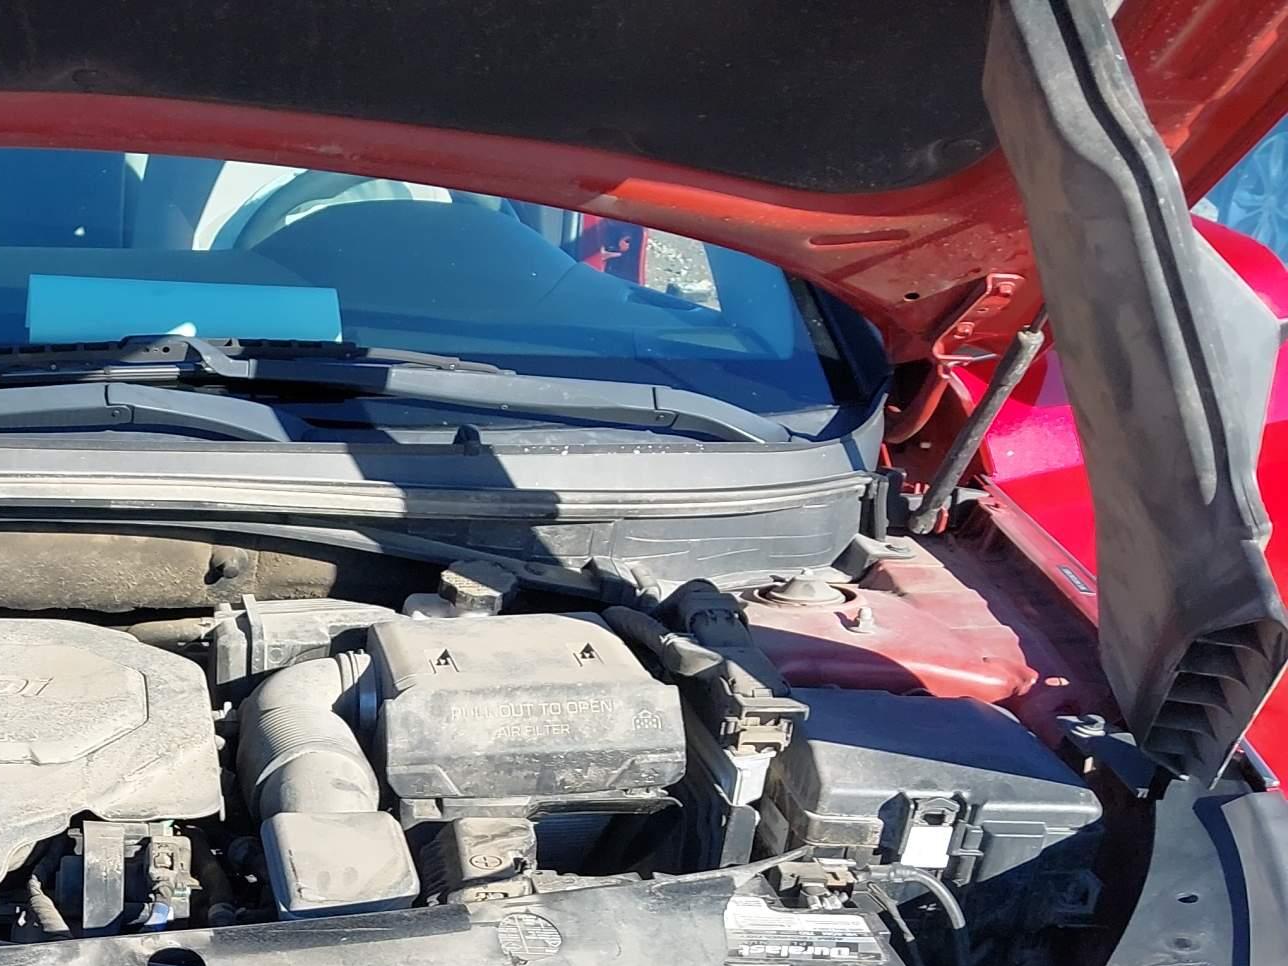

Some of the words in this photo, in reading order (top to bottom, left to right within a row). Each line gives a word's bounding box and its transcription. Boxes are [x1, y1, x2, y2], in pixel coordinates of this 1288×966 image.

[450, 705, 496, 721] PULL
[499, 703, 534, 718] OUT
[538, 702, 562, 716] TO
[495, 725, 522, 738] AIR
[525, 723, 571, 737] FILTER
[738, 944, 850, 959] Duralast
